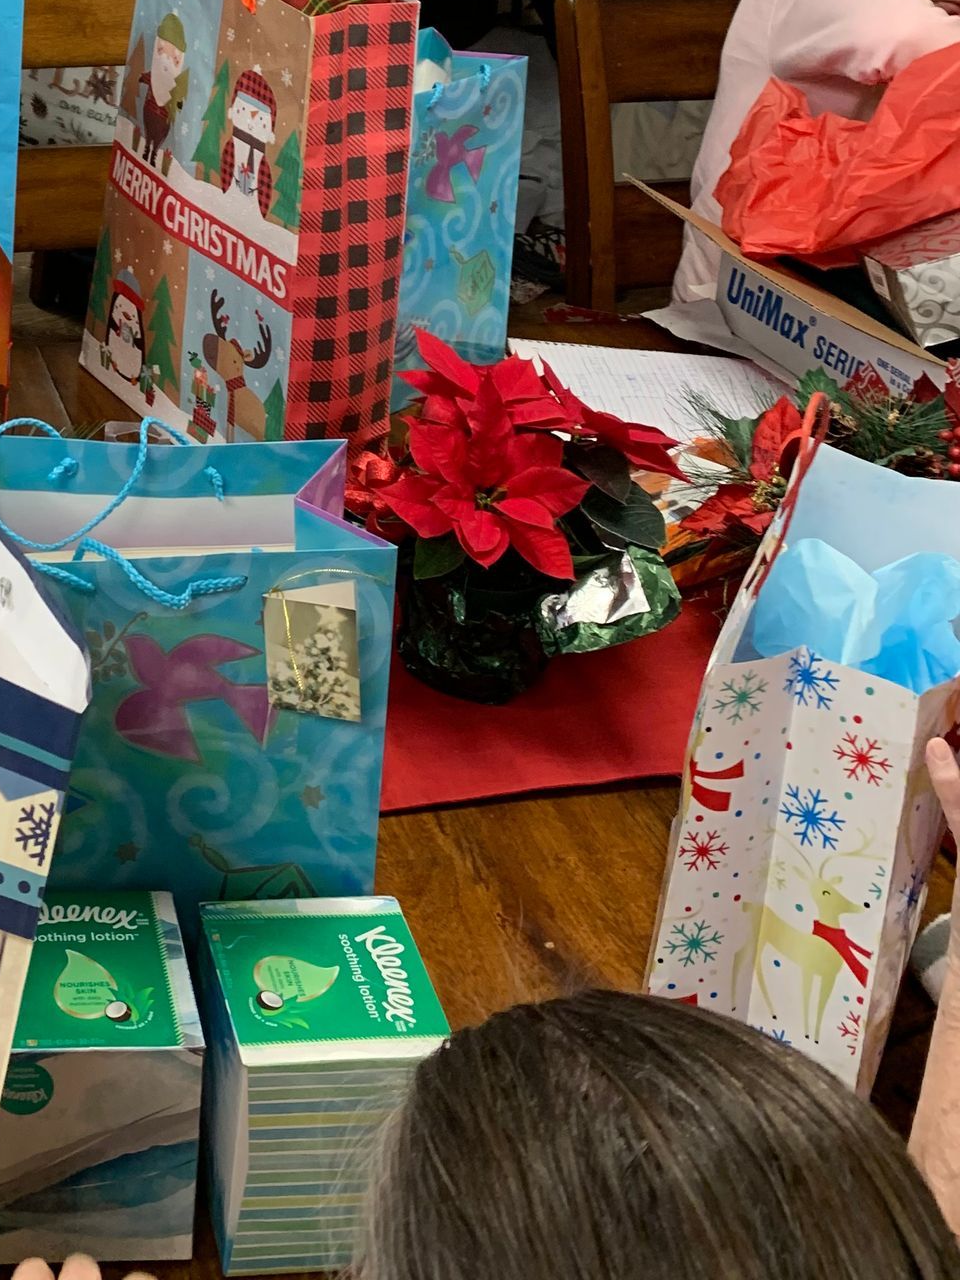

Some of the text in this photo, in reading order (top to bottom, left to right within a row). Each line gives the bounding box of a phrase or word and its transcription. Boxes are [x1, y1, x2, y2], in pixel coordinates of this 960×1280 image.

[112, 149, 288, 299] MERRY CHRISTMAS
[813, 334, 865, 379] SERI
[37, 898, 138, 930] leenex
[91, 931, 135, 941] lotion
[338, 933, 379, 1021] soothing lotion
[354, 925, 417, 1024] Kleenex
